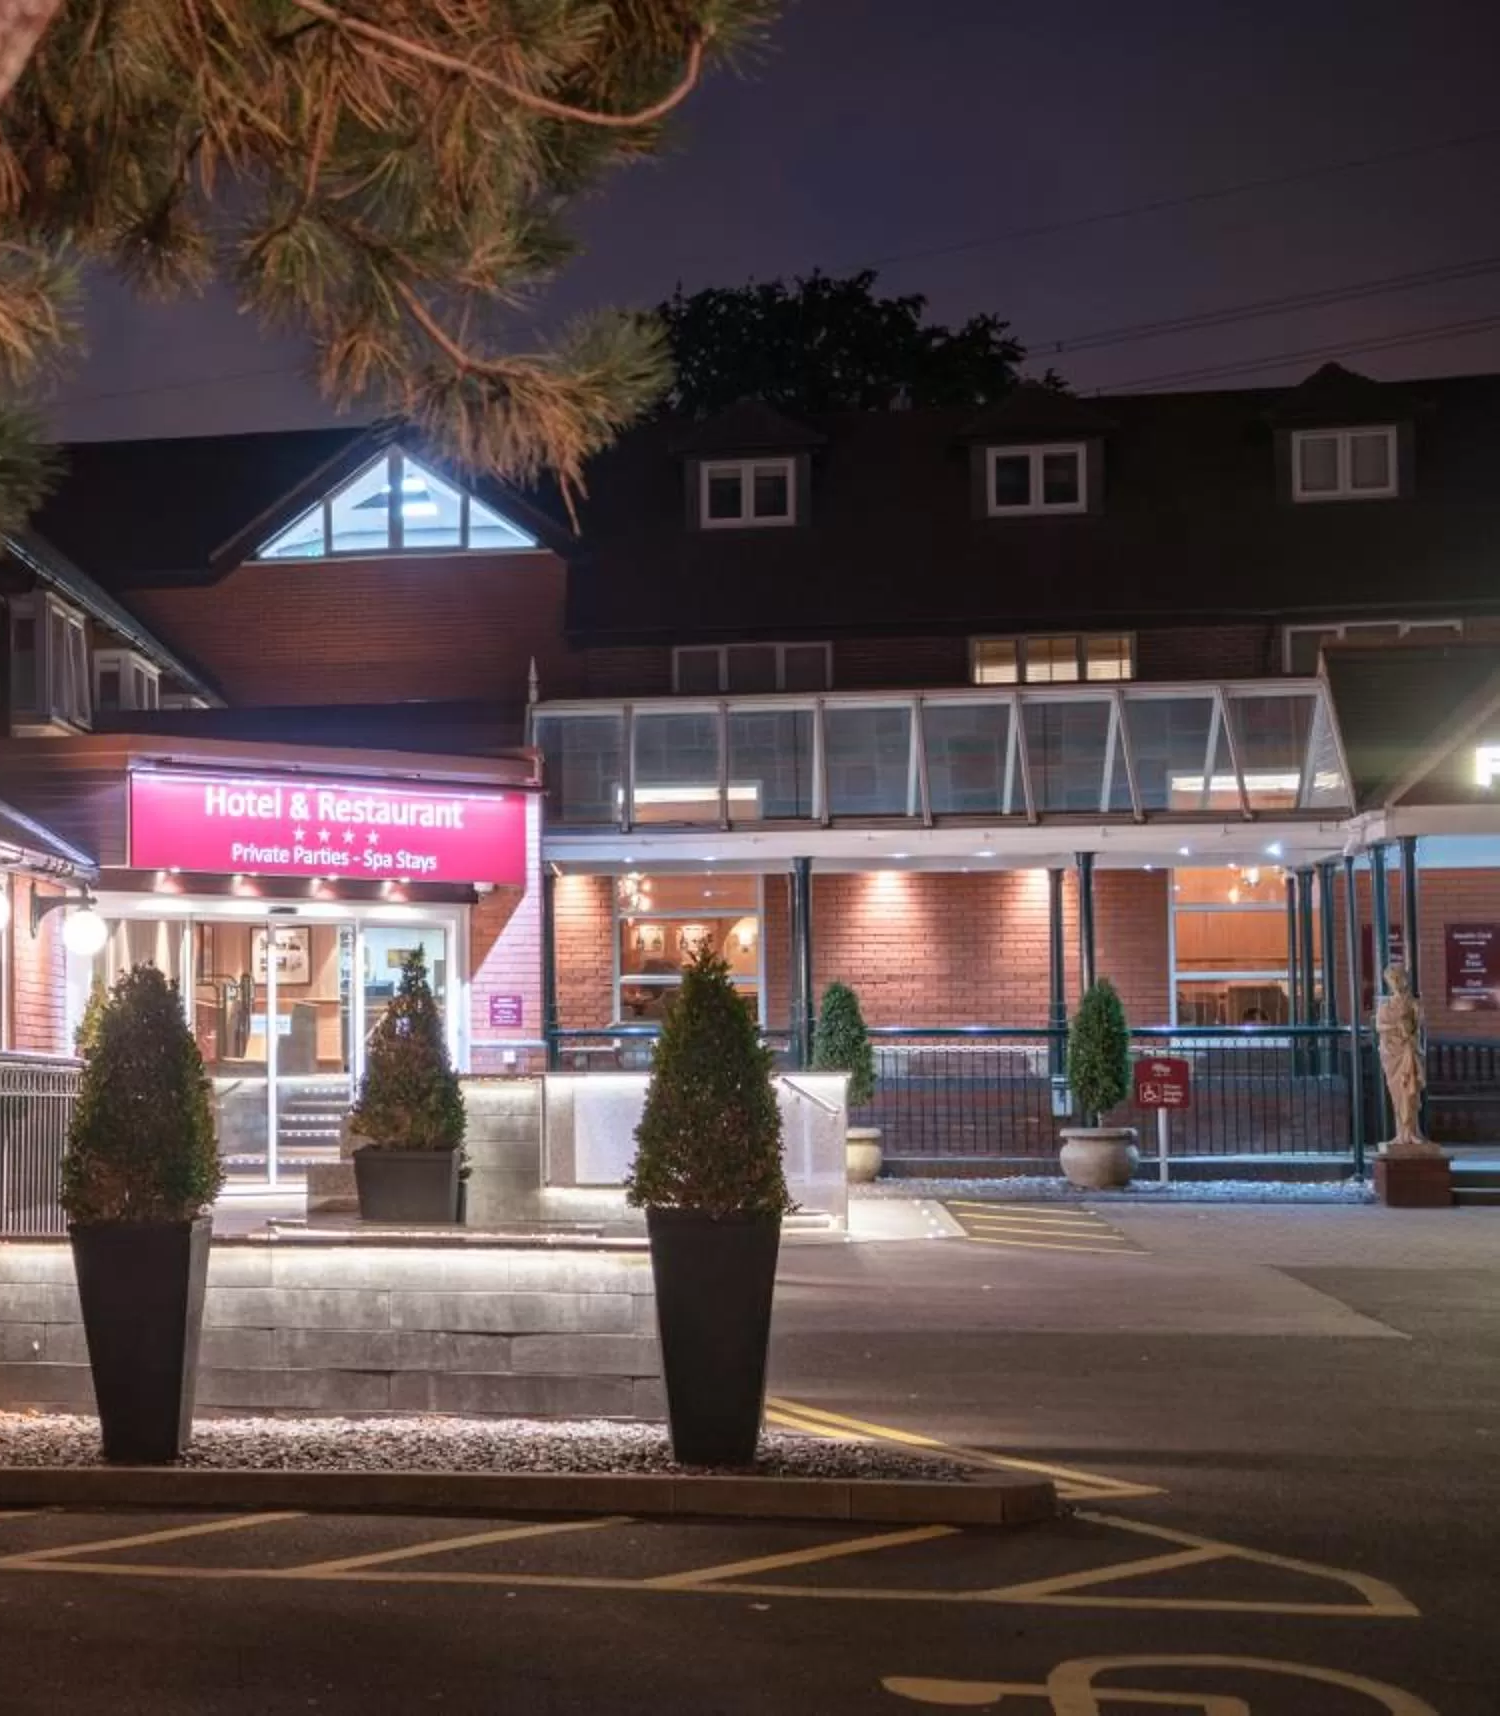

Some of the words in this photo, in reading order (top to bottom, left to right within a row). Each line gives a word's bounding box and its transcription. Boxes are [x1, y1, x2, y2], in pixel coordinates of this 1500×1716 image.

[203, 785, 283, 819] Hotel
[289, 792, 310, 821] &
[317, 791, 465, 829] Restaurant
[231, 843, 289, 864] Private
[294, 845, 349, 867] Parties
[363, 849, 392, 871] Spa
[396, 850, 437, 873] Stays
